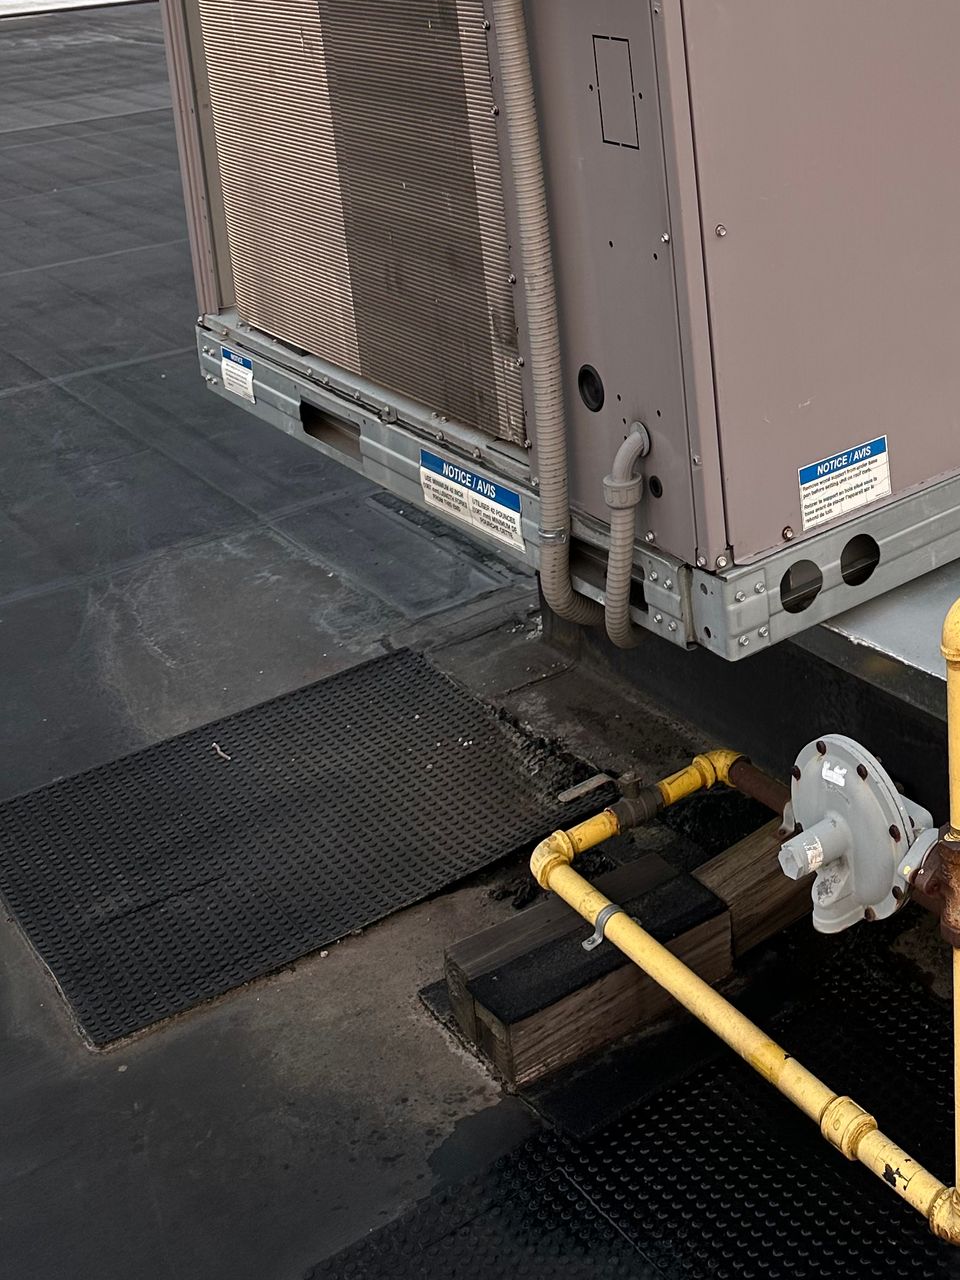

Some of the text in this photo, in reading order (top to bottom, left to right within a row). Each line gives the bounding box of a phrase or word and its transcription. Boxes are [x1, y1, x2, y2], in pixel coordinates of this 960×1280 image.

[817, 455, 848, 475] NOTICE
[853, 446, 871, 461] AVIS
[442, 463, 471, 487] NOTICE
[476, 481, 496, 498] AVIS
